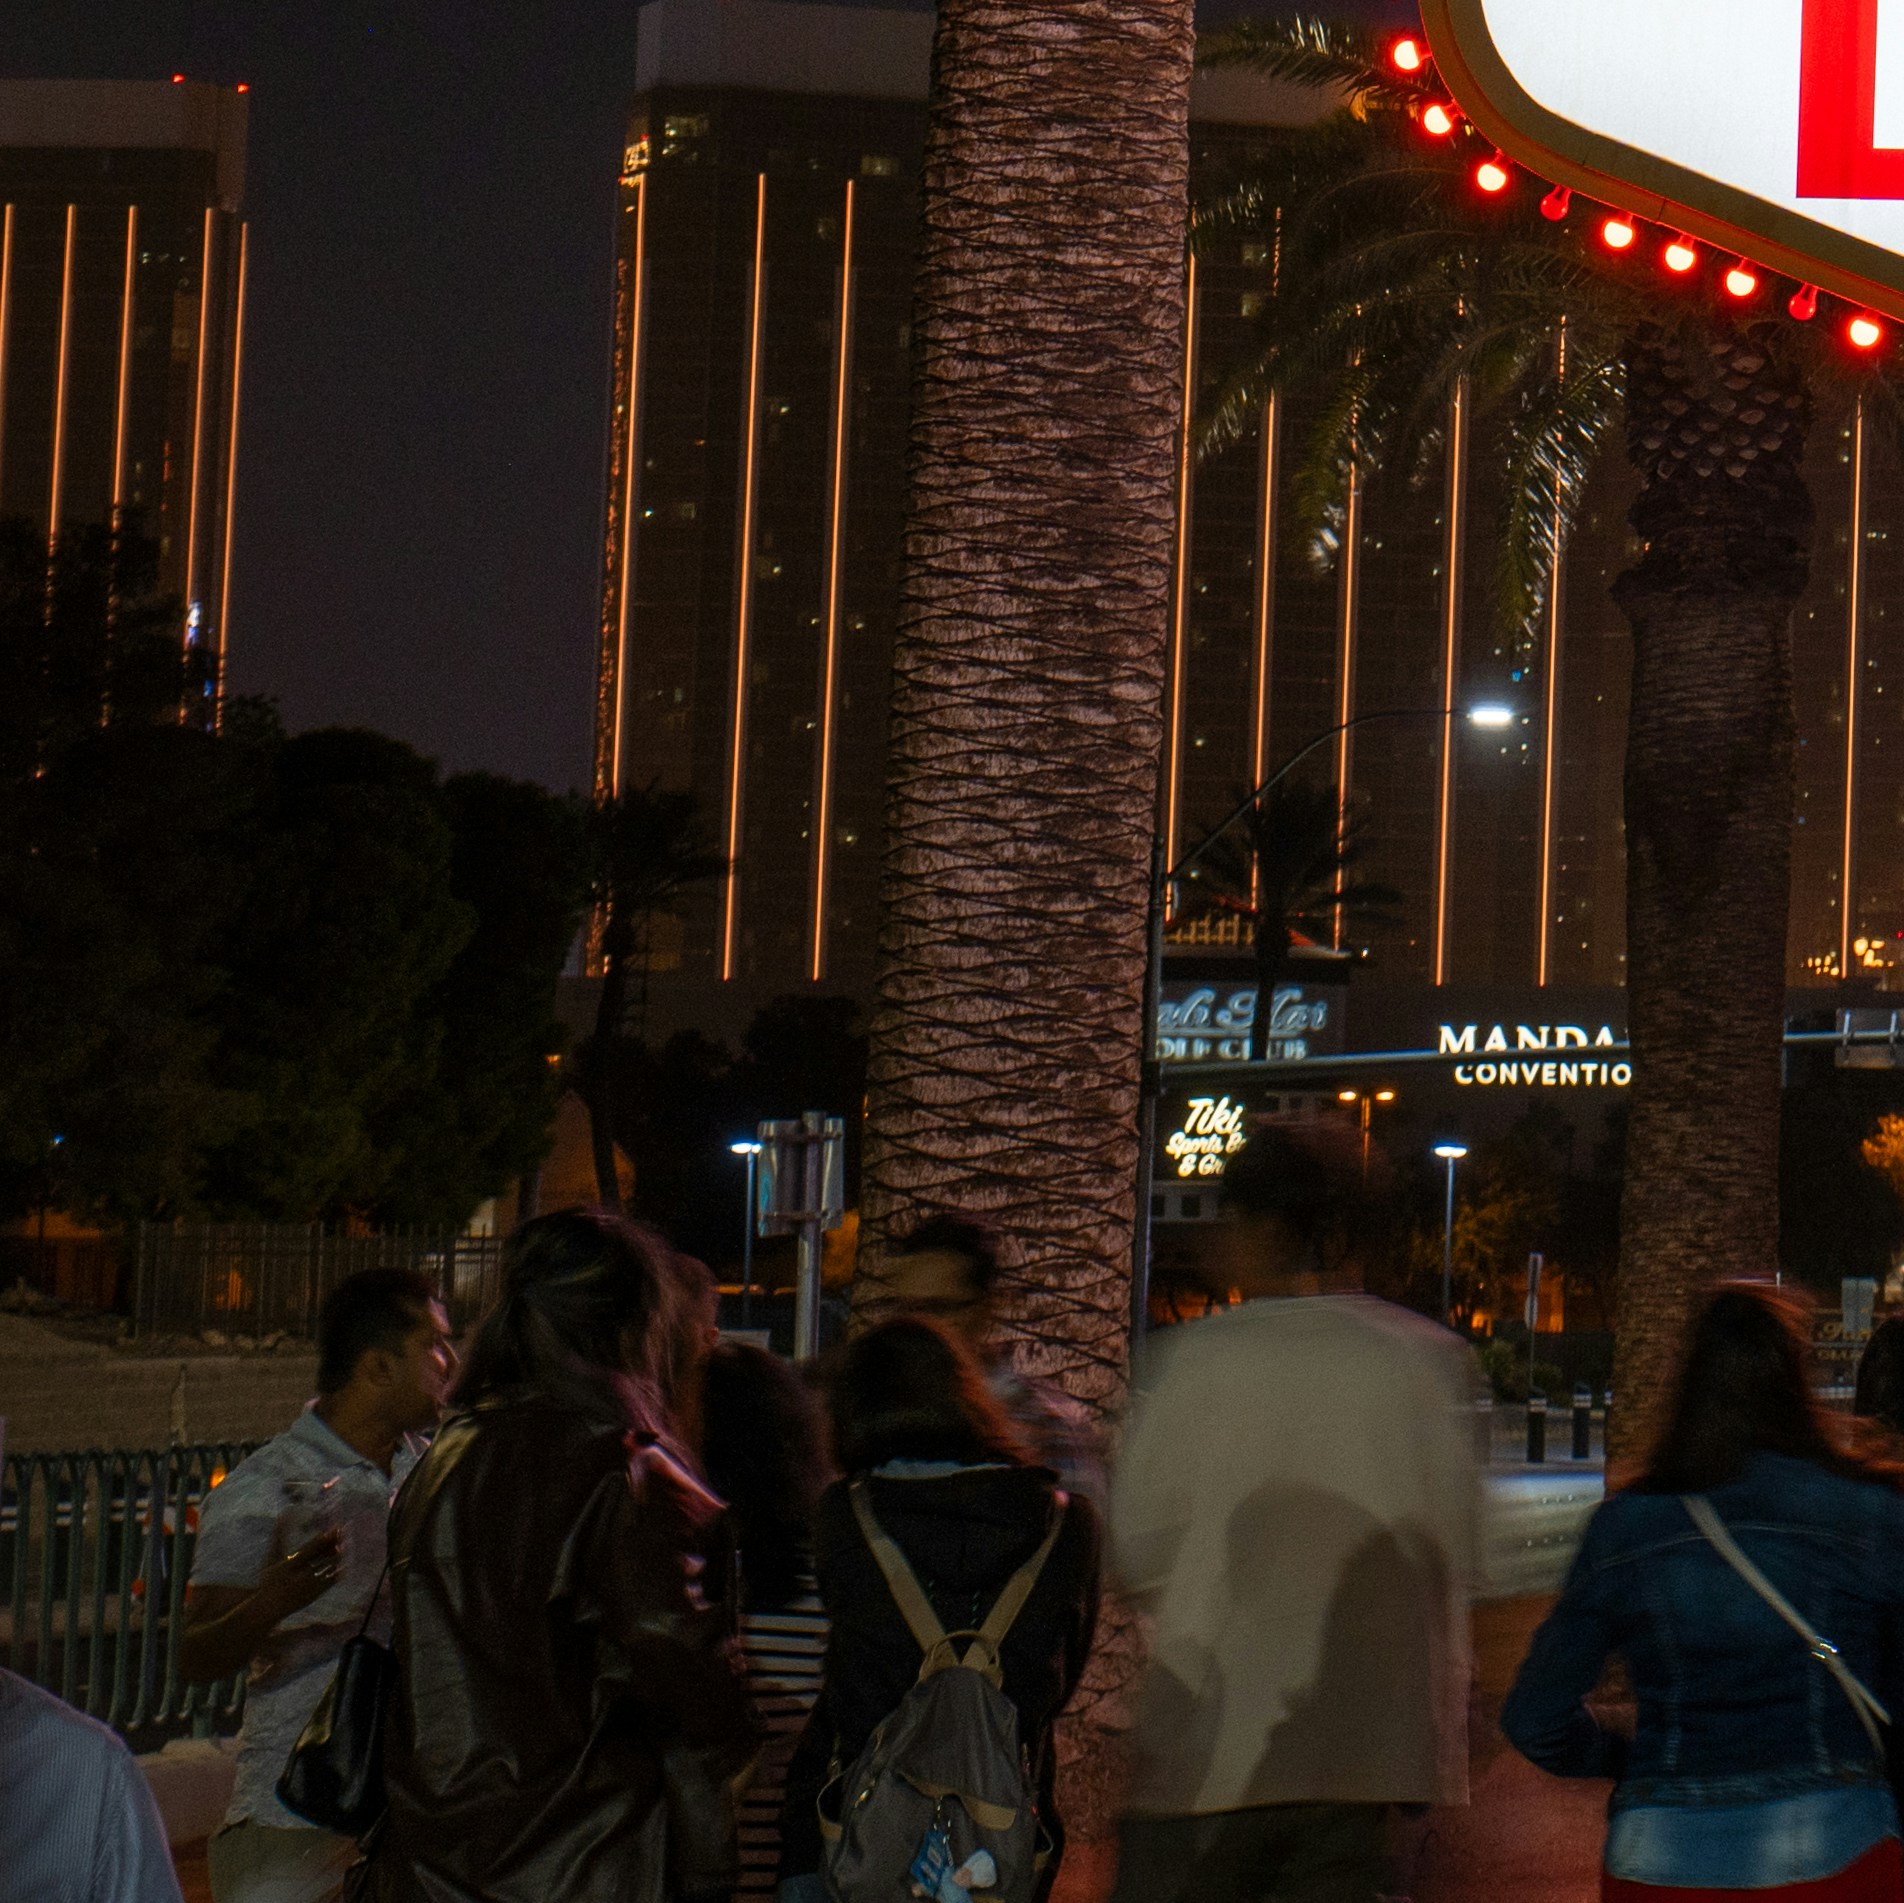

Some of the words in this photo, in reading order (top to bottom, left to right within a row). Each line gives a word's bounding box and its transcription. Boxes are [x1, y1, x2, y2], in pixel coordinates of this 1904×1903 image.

[1439, 1024, 1627, 1053] MANDA
[1455, 1062, 1632, 1085] CONVENTIO
[1186, 1097, 1244, 1134] Tiki
[1166, 1131, 1224, 1158] Sports
